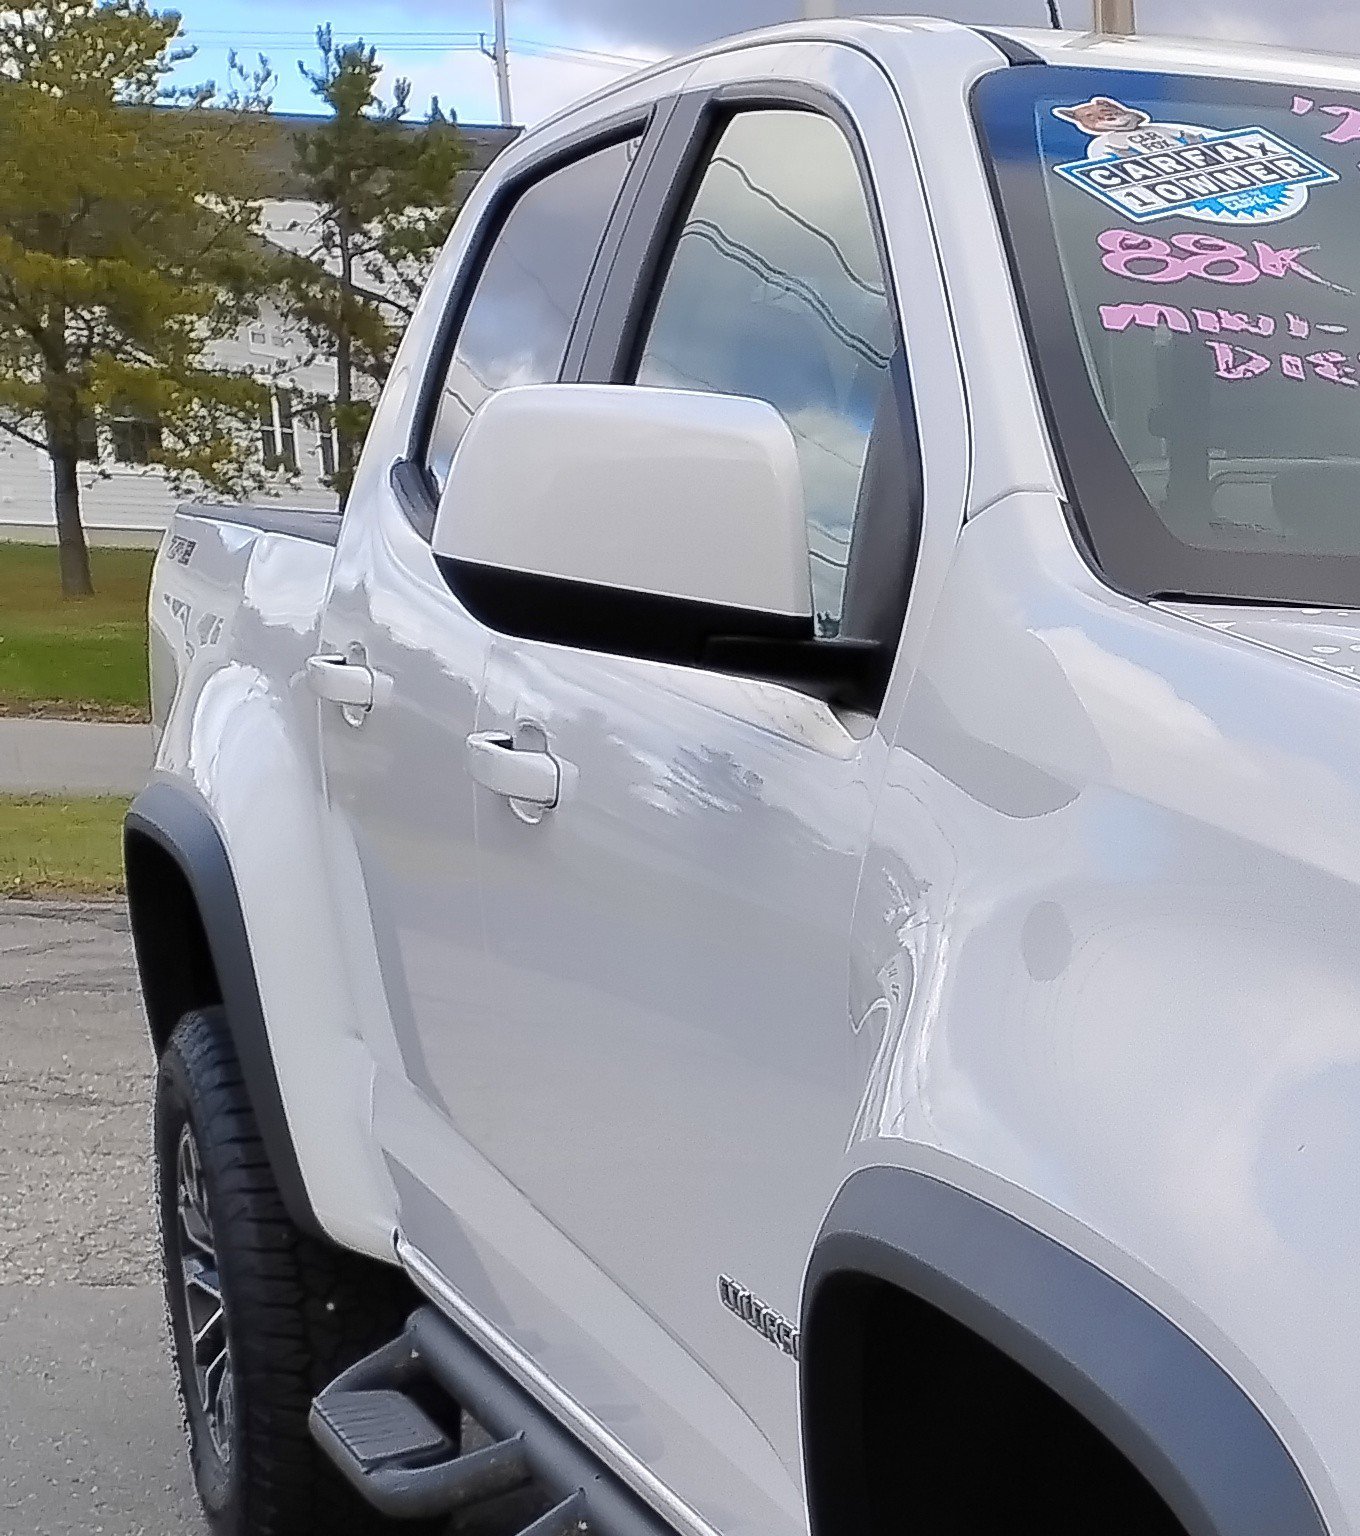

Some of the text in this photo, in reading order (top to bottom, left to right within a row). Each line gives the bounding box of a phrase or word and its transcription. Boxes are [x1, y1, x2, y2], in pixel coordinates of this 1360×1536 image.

[1088, 140, 1278, 187] CARFAX
[1122, 189, 1154, 210] 1
[1153, 158, 1311, 200] OWNER
[1096, 228, 1357, 297] 88K
